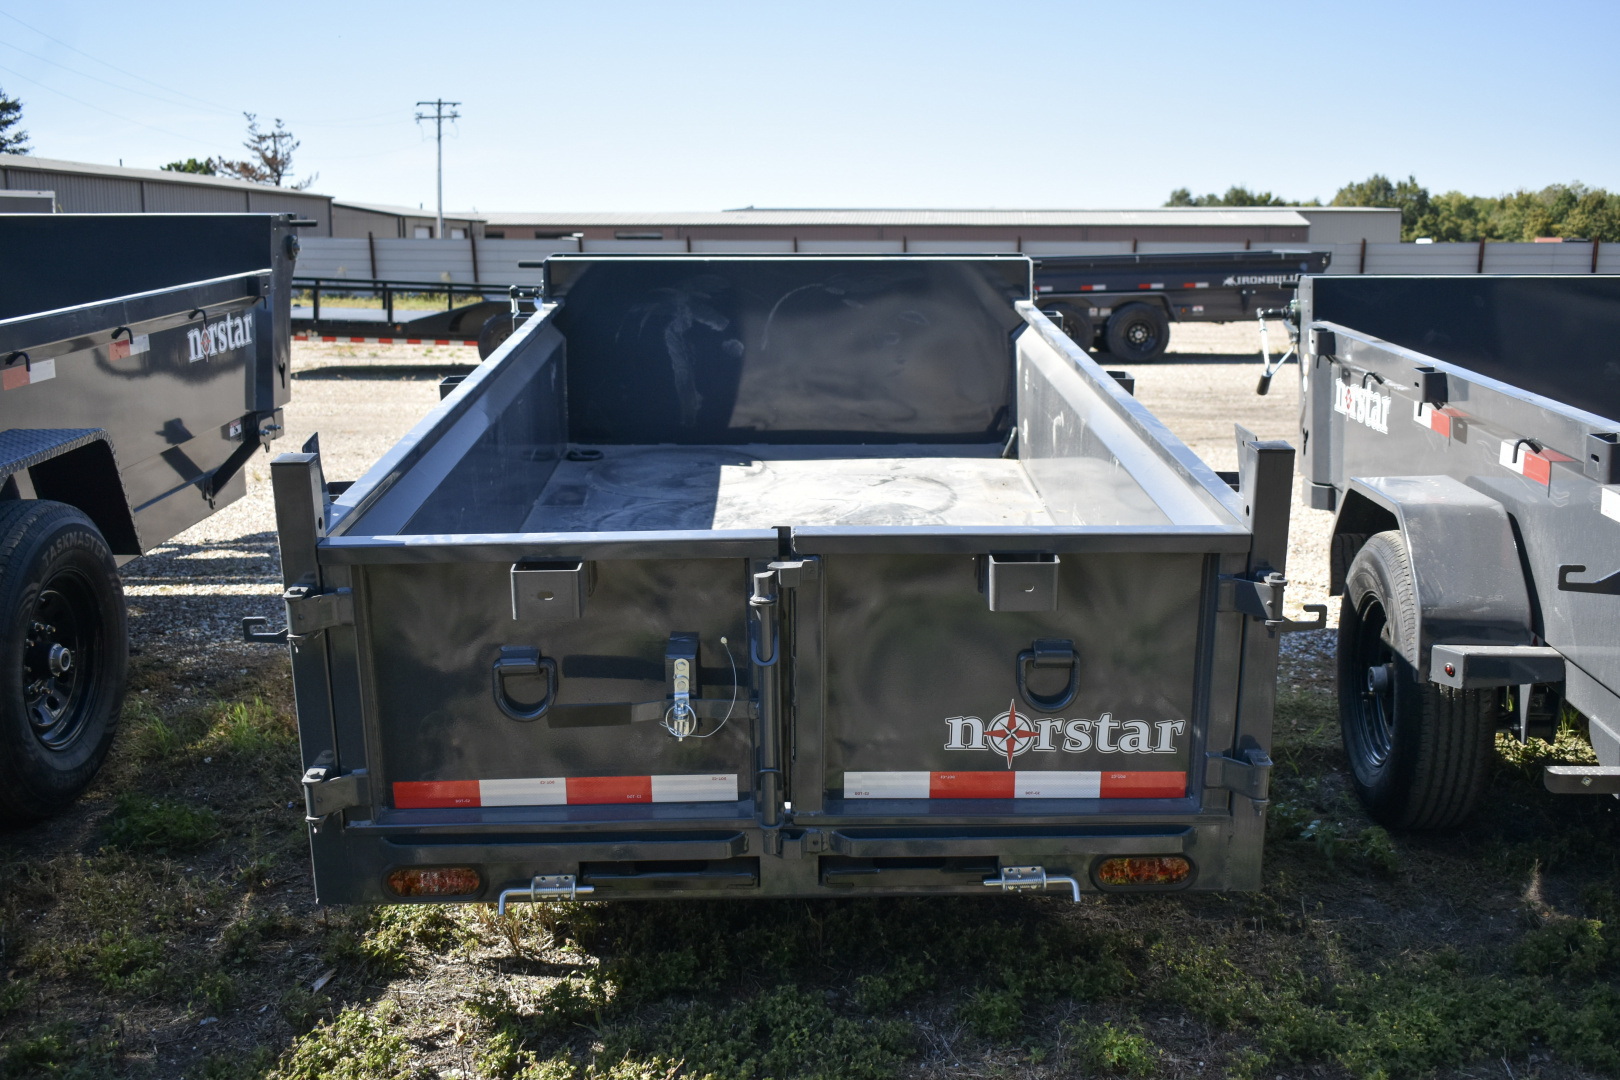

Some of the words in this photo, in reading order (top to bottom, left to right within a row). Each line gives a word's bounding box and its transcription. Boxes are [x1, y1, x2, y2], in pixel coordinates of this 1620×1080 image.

[187, 312, 253, 362] norstar
[1333, 377, 1391, 434] norstar
[41, 531, 107, 567] TASKMASTER
[944, 702, 1186, 764] norstar
